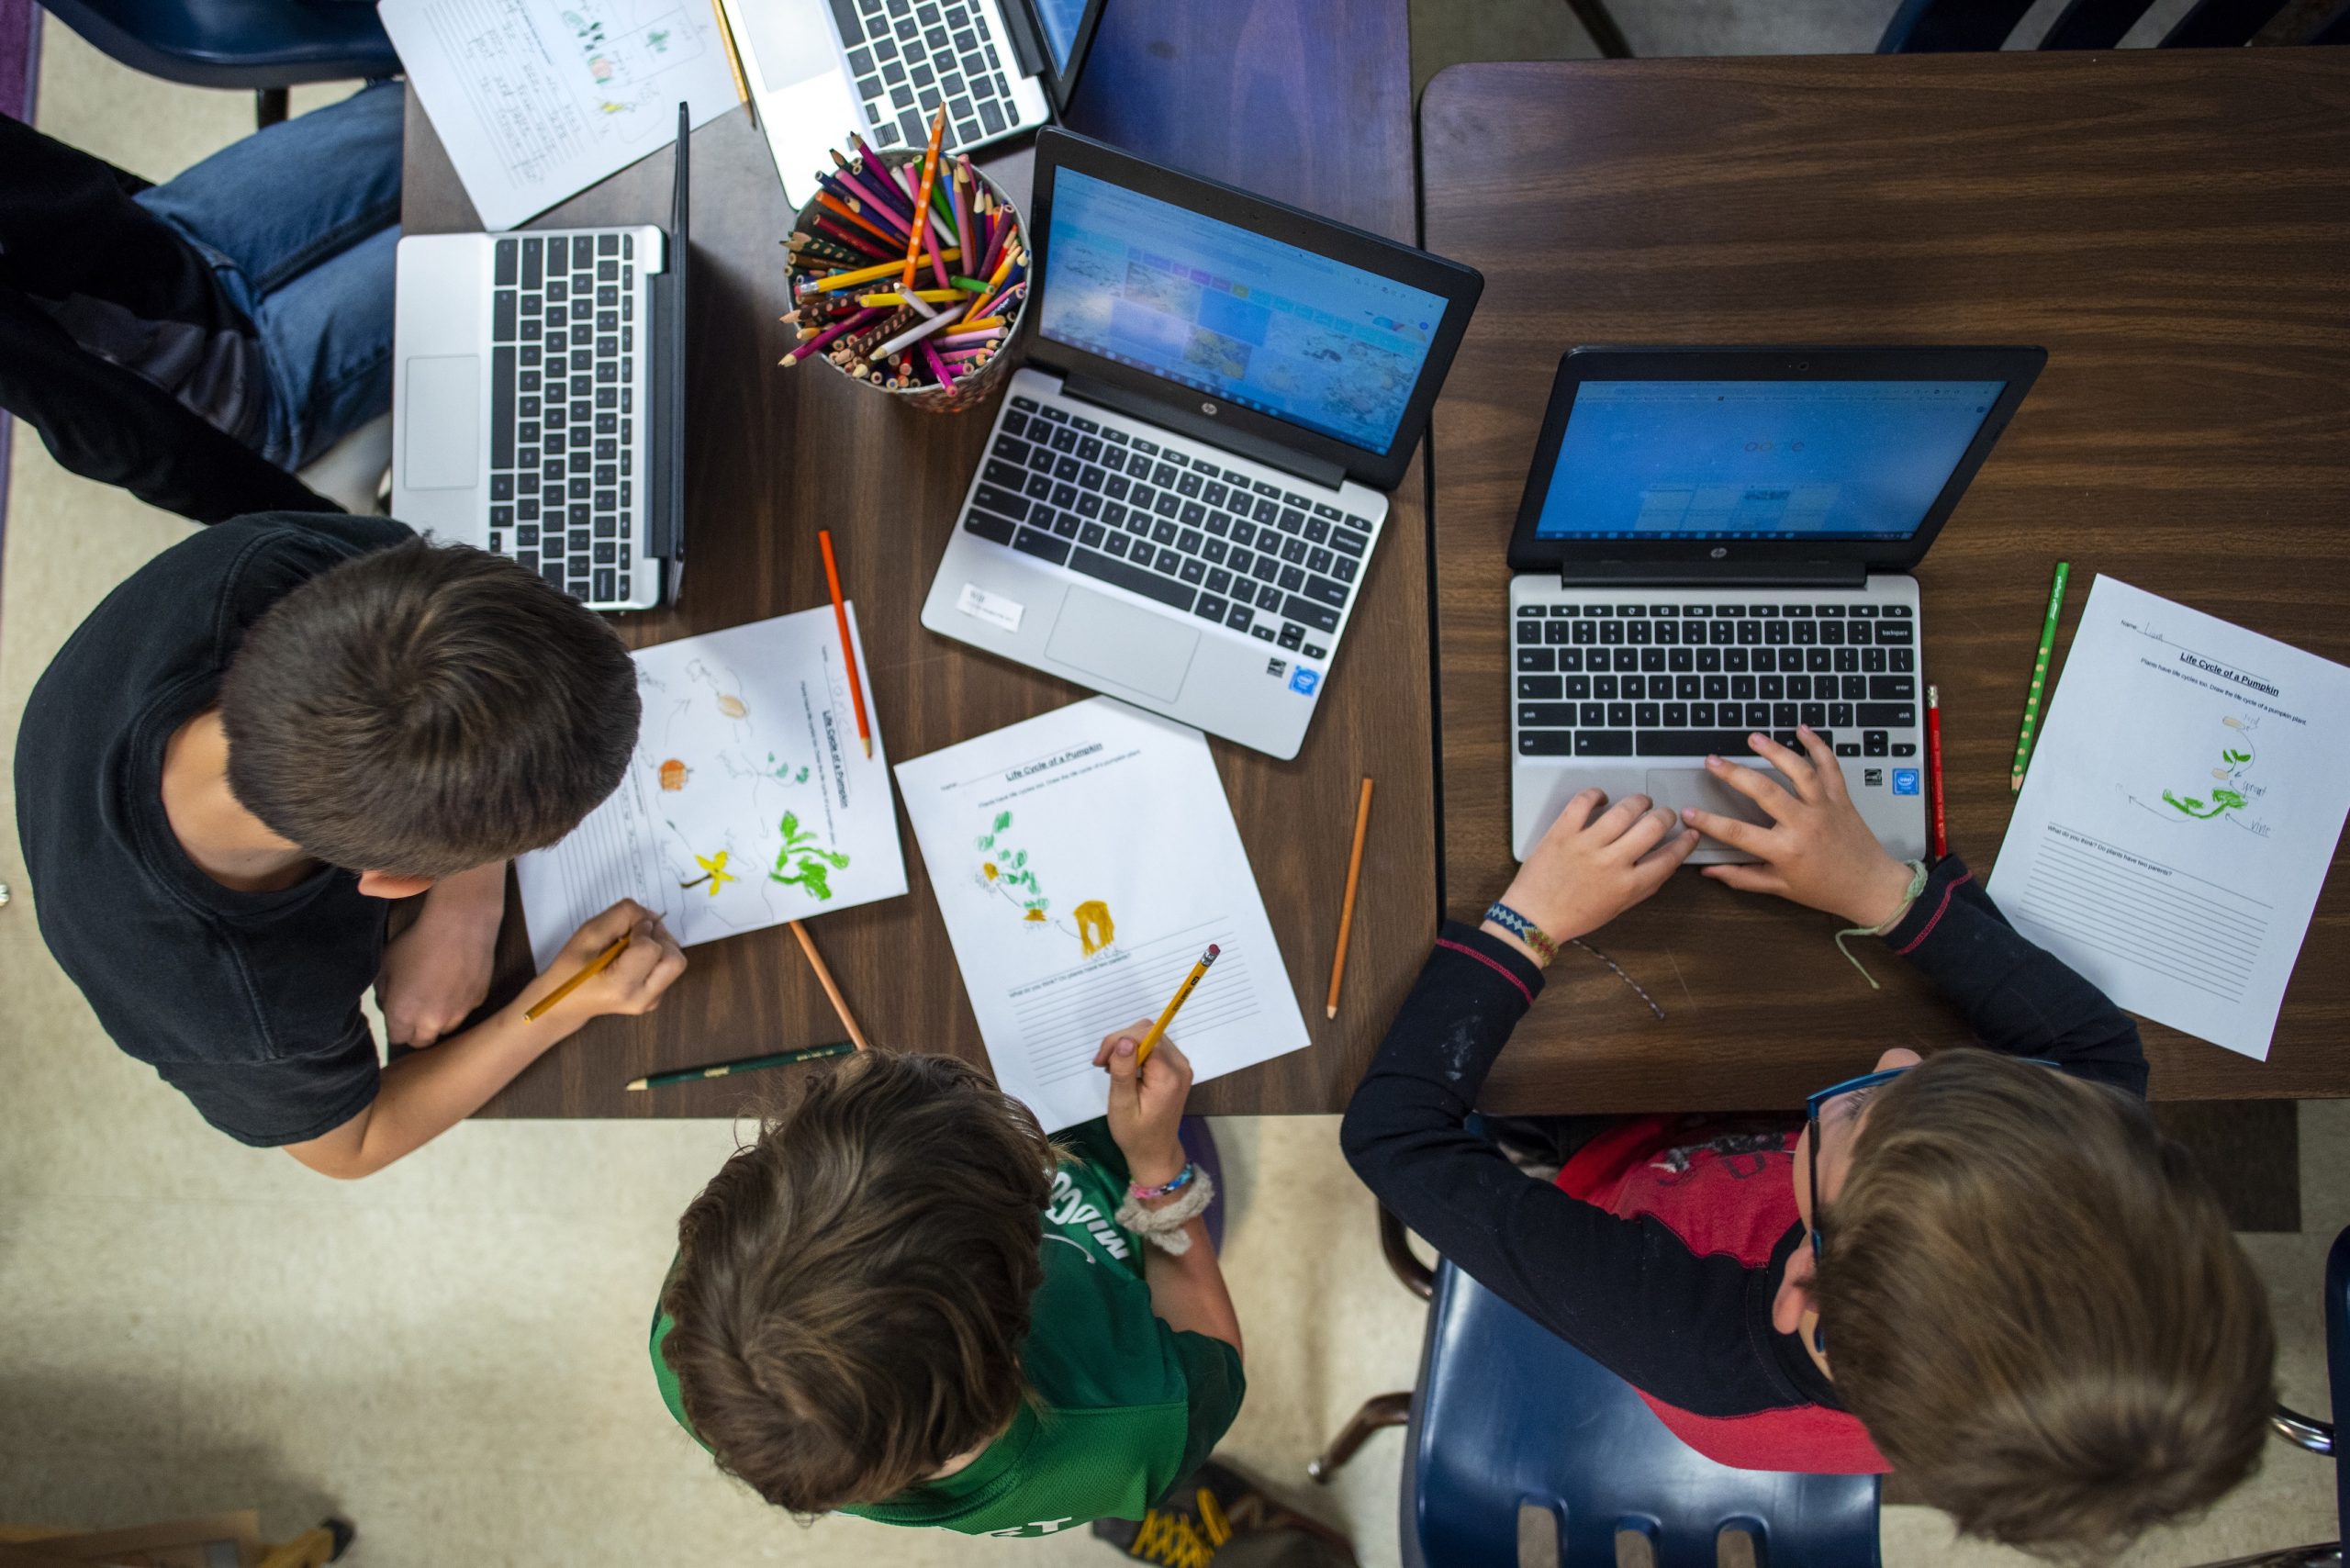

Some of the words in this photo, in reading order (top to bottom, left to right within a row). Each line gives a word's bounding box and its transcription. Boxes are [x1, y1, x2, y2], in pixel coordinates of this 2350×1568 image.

[2180, 653, 2197, 665] Life
[2198, 659, 2221, 674] Cycle
[2223, 669, 2232, 678] of
[2241, 676, 2279, 696] Pumpkin
[1005, 769, 1022, 780] Life
[1024, 761, 1046, 775] Cycle
[1048, 756, 1058, 766] of
[1066, 742, 1102, 760] Pumpkin
